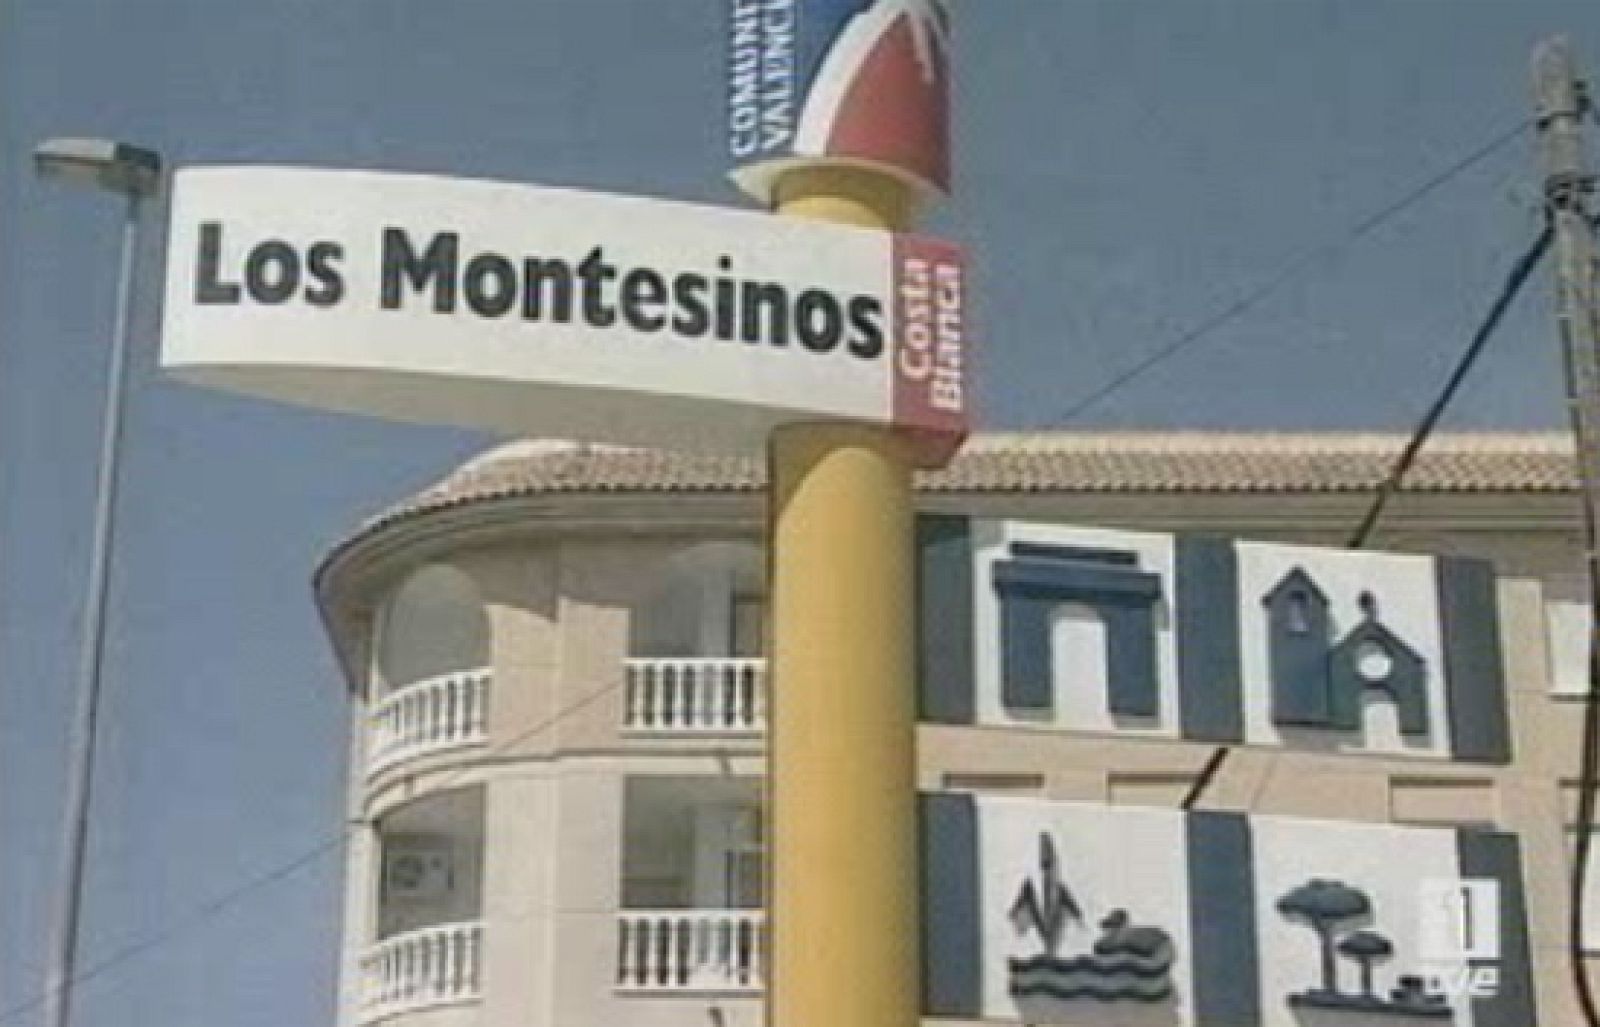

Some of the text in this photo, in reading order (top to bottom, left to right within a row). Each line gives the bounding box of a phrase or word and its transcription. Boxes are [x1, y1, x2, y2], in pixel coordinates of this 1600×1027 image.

[730, 0, 758, 156] COMUNI
[194, 221, 885, 360] Los Montesinos
[901, 258, 932, 381] Costa
[930, 264, 963, 411] Blanca
